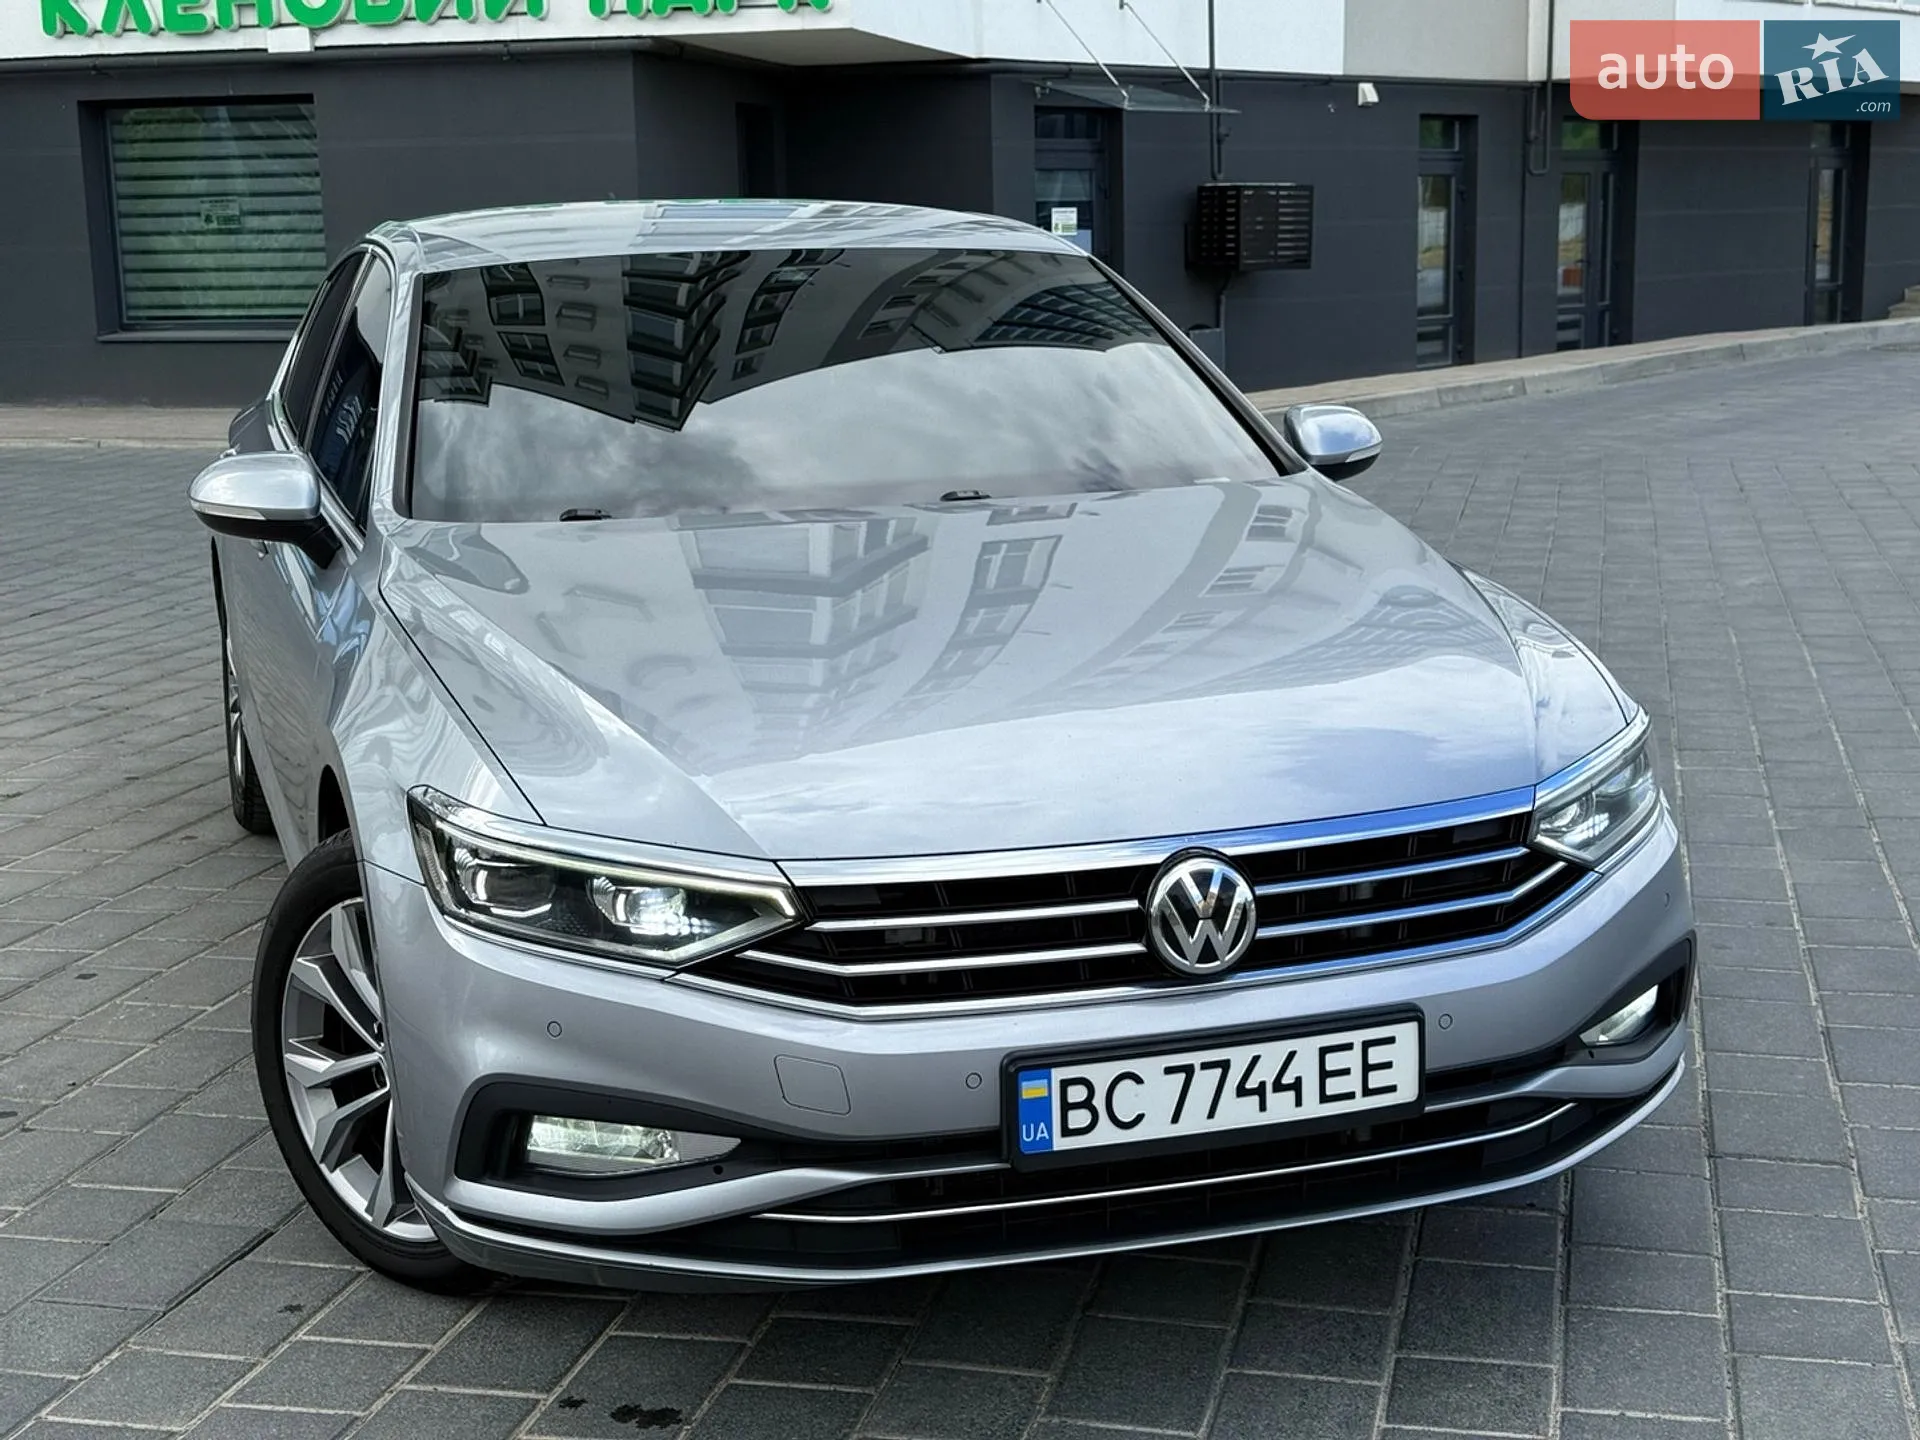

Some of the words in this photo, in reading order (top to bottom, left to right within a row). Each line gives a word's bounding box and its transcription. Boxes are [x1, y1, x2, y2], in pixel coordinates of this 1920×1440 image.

[1059, 1071, 1146, 1138] BC
[1163, 1049, 1303, 1125] 7744
[1318, 1035, 1398, 1105] EE
[1022, 1122, 1049, 1142] UA
